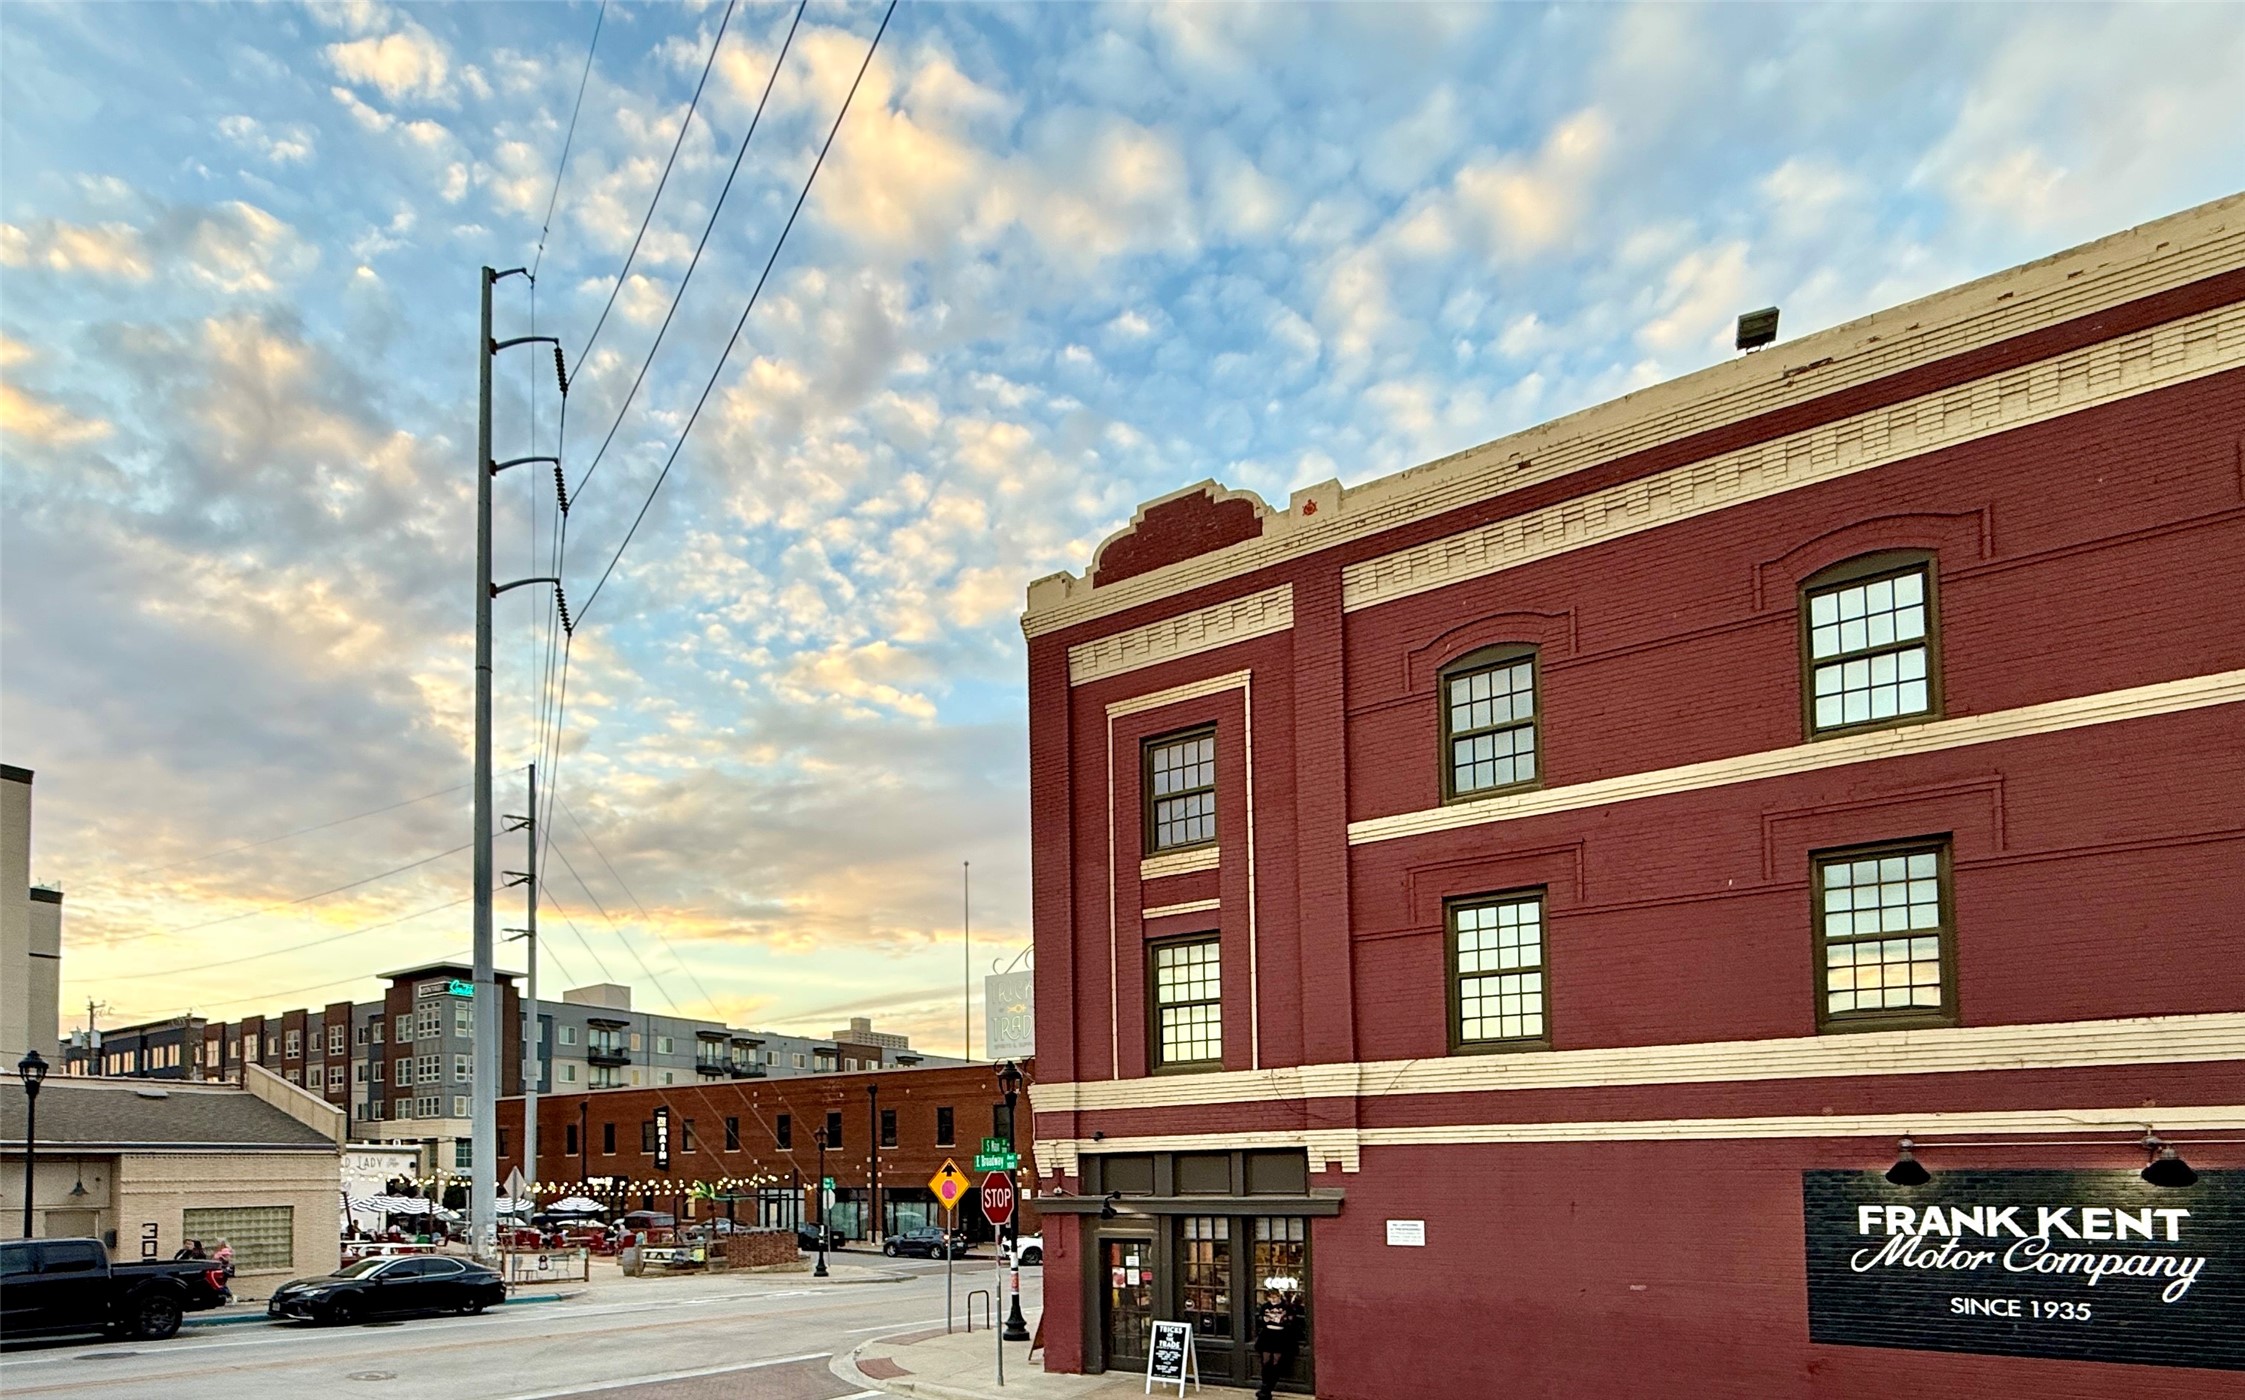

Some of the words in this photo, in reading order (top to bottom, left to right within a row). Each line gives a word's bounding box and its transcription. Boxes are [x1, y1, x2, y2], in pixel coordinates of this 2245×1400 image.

[991, 979, 1034, 1004] TRICK
[991, 1015, 1034, 1041] TRAD
[356, 1156, 383, 1170] LADY
[981, 1155, 1004, 1169] Broadway
[984, 1188, 1012, 1209] STOP
[1858, 1205, 2029, 1237] FRANK
[2037, 1206, 2192, 1241] KENT
[142, 1222, 158, 1262] 30
[1850, 1232, 1996, 1272] Motor
[2003, 1235, 2206, 1304] Company
[1950, 1297, 2022, 1317] SINCE
[2030, 1300, 2092, 1321] 1935
[1160, 1325, 1183, 1334] TRICKS
[1159, 1340, 1181, 1349] TRADE
